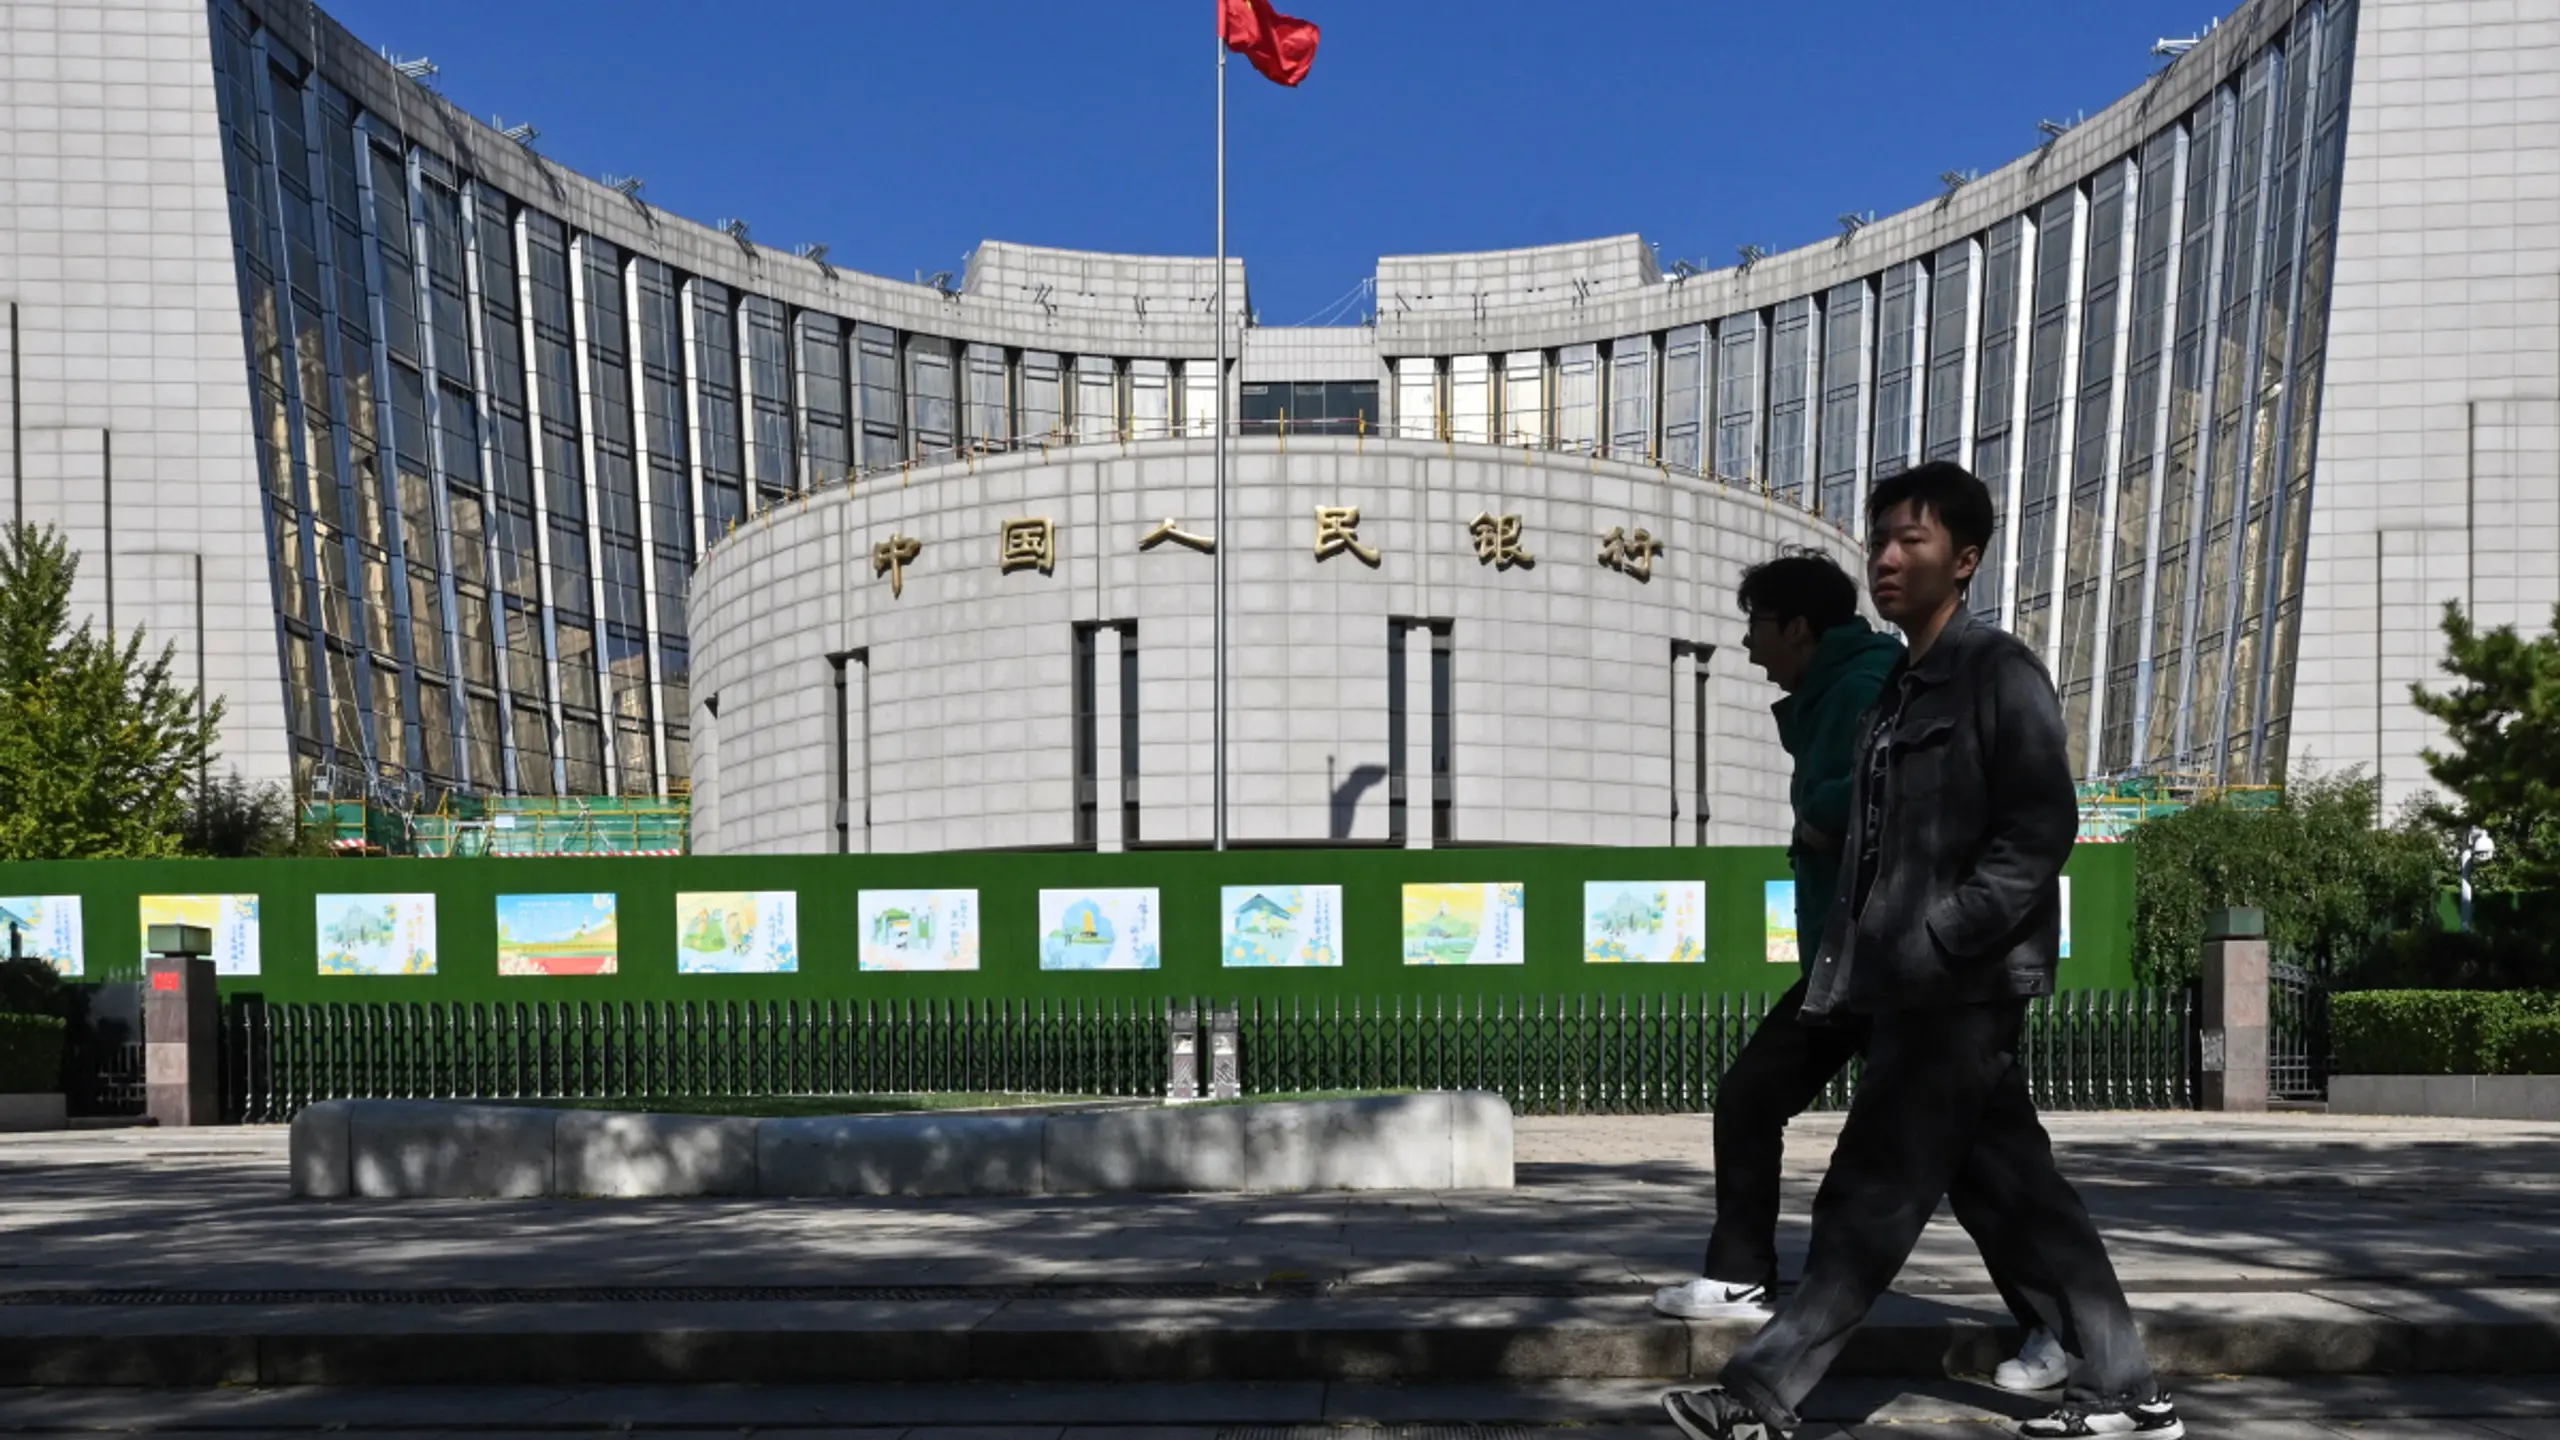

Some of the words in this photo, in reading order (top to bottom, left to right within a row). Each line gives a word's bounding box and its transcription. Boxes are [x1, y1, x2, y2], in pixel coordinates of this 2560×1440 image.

[873, 506, 1664, 600] 中国人民银行
